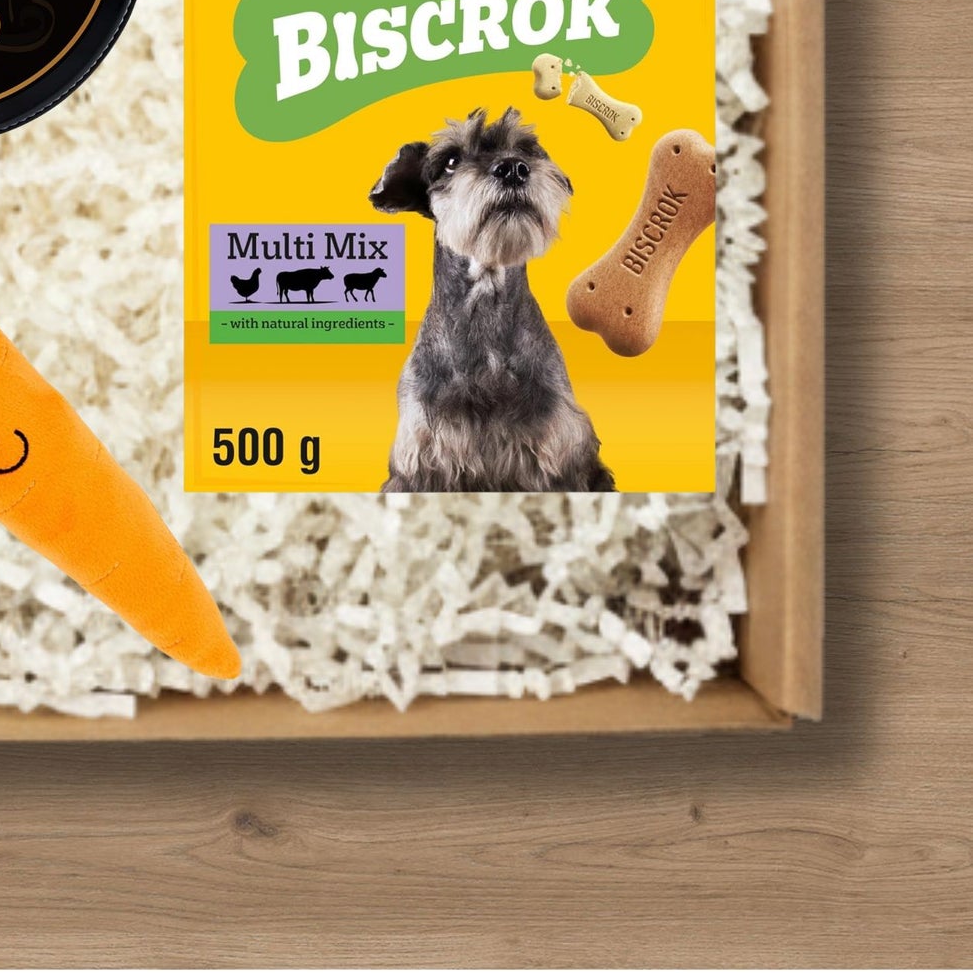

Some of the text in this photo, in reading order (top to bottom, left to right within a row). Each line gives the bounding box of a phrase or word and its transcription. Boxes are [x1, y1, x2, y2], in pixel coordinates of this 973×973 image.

[584, 93, 620, 124] BISCROK
[227, 232, 389, 260] Multi Mix
[620, 184, 690, 279] BISCROK
[230, 317, 386, 332] with natural ingredients
[212, 427, 321, 475] 500 g
